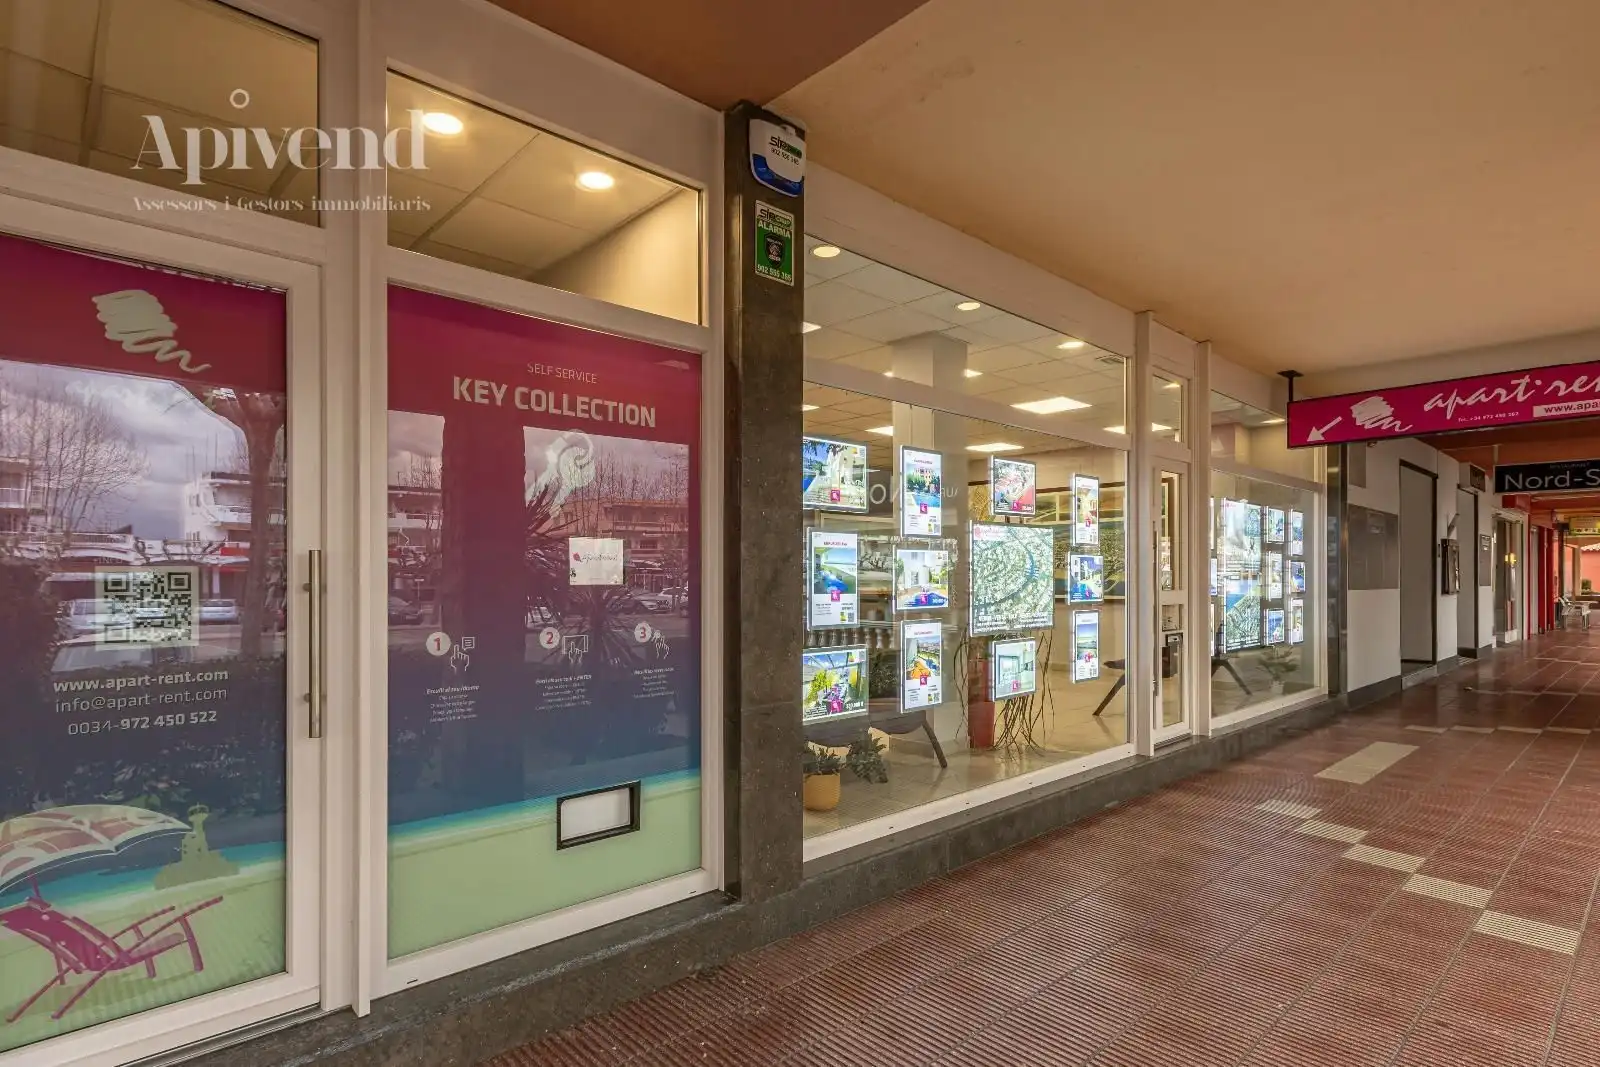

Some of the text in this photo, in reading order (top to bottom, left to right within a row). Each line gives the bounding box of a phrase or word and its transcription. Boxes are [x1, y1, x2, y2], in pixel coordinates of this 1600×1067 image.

[758, 220, 791, 239] ALARMA
[527, 363, 599, 384] SELF SERVICE
[453, 376, 657, 428] KEY COLLECTION
[546, 632, 554, 644] 2
[641, 627, 647, 639] 3
[434, 637, 441, 651] 1
[53, 670, 229, 693] www.apart-rent.com
[56, 688, 227, 713] info@apart-rent.com
[68, 711, 217, 735] 0034-972 450 522
